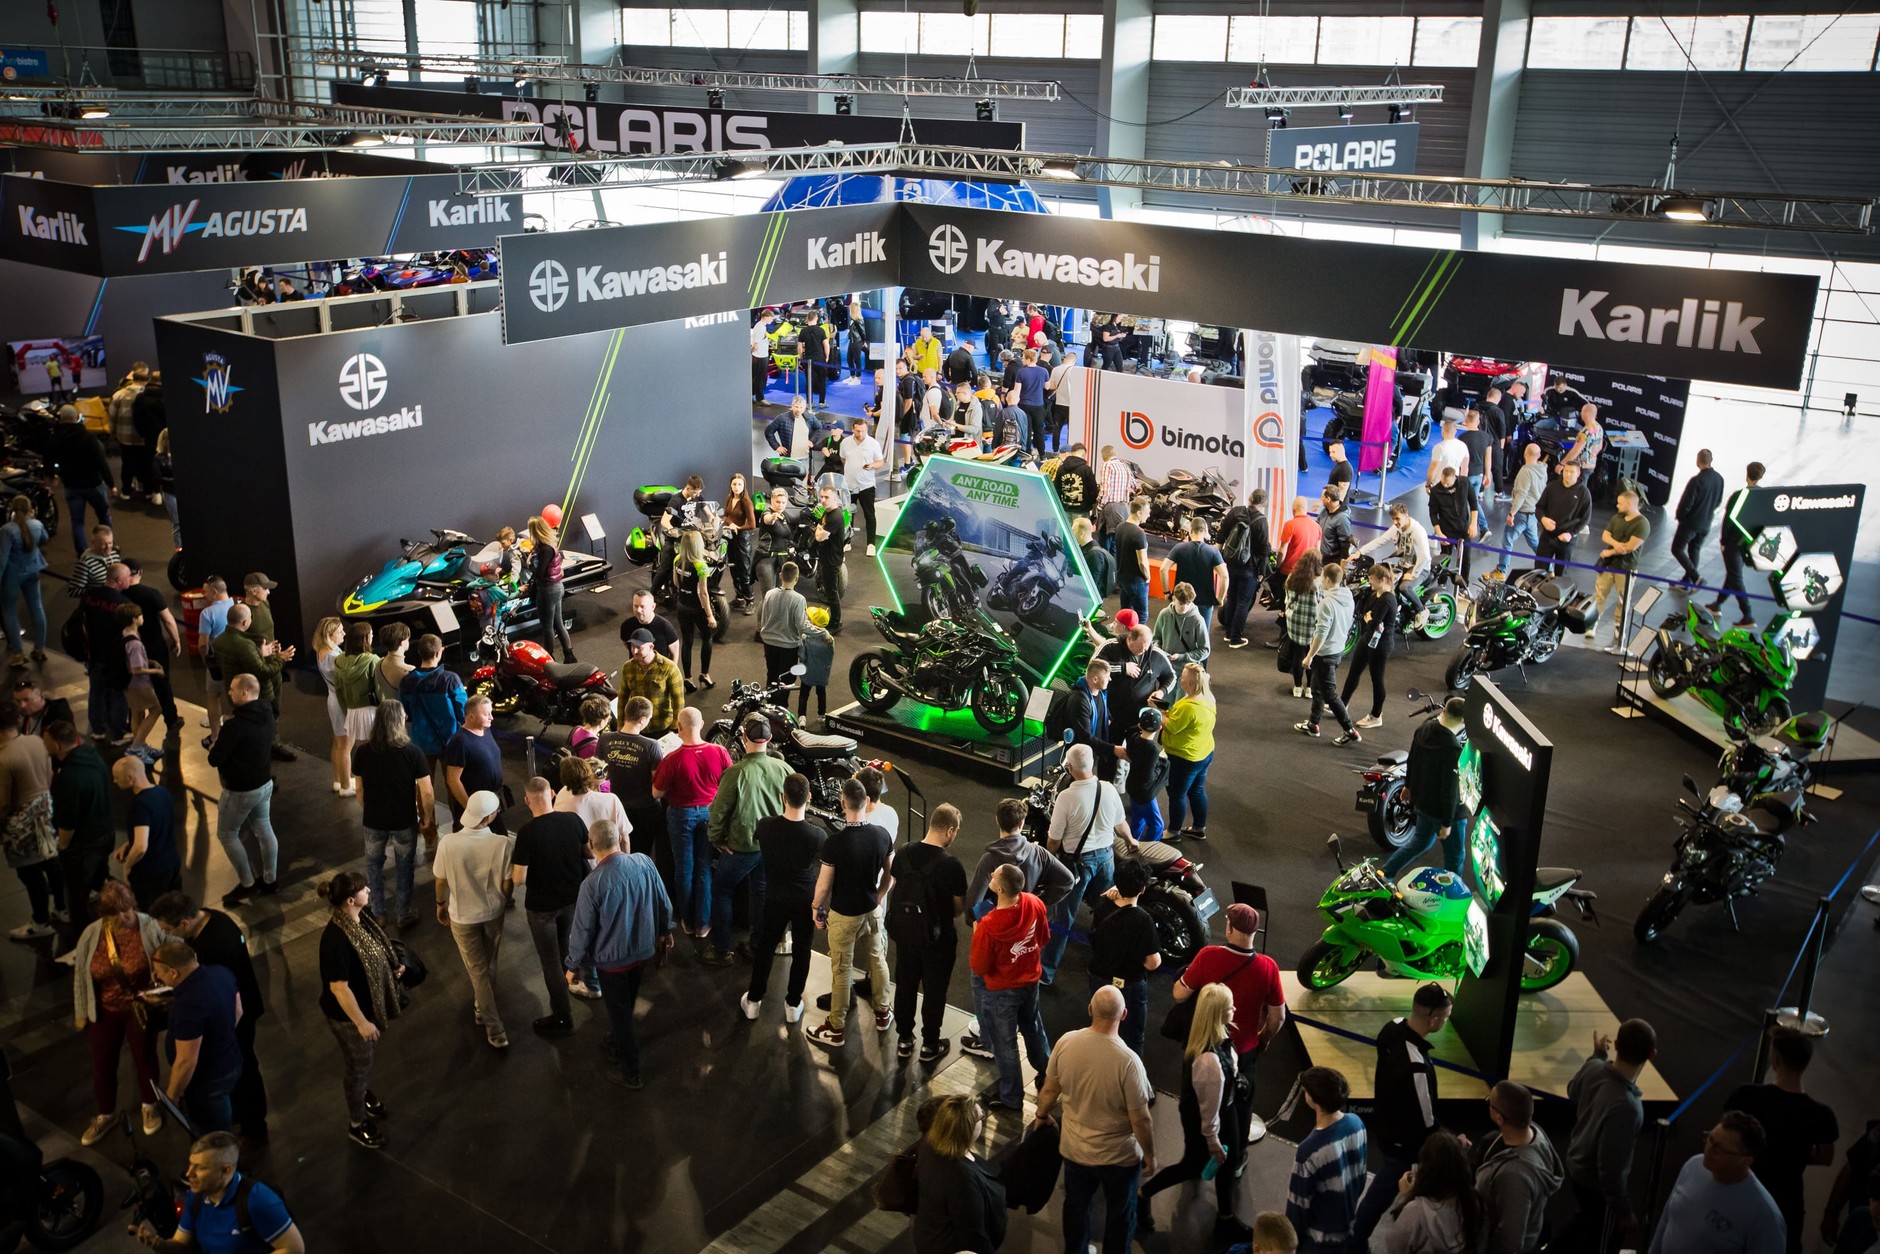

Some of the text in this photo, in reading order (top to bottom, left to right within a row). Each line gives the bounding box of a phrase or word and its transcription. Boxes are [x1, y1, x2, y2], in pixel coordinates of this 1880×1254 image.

[502, 100, 772, 155] POLARIS
[1295, 138, 1397, 171] POLARIS
[18, 204, 88, 246] Karlik
[428, 196, 512, 228] Karlik
[137, 199, 308, 264] MV AGUSTA
[807, 231, 888, 271] Karlik
[976, 237, 1161, 293] Kawasaki
[577, 251, 728, 303] Kawasaki
[1558, 287, 1766, 355] Karlik
[1550, 369, 1585, 382] POARIS
[1612, 381, 1643, 395] POLARIS
[1635, 406, 1660, 420] POLARIS
[1659, 394, 1684, 408] POLARIS
[308, 404, 423, 447] Kawasaki
[1605, 417, 1636, 430] POLARIS
[1654, 431, 1677, 446] POLARIS
[1161, 425, 1244, 458] bimota
[957, 476, 1014, 494] ANY ROAD.
[966, 489, 1020, 509] ANY TIME.
[1790, 494, 1856, 510] Kawasaki
